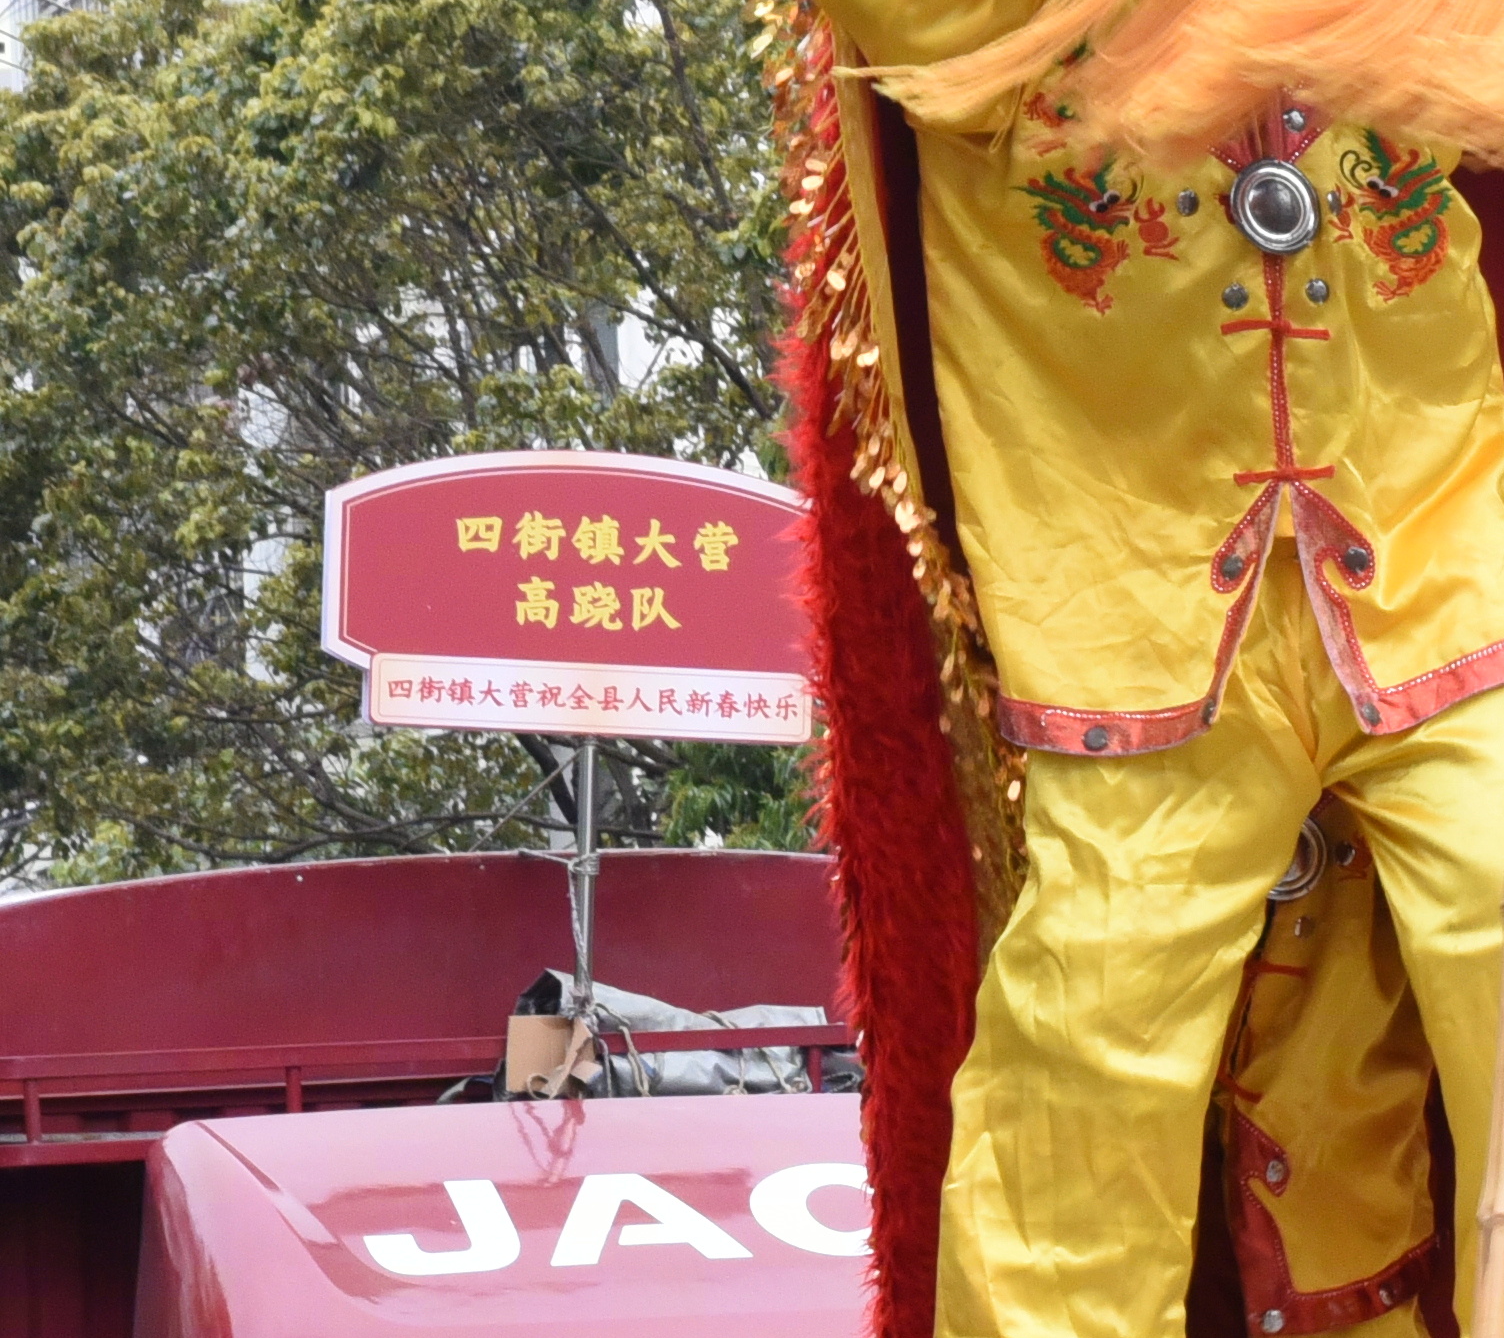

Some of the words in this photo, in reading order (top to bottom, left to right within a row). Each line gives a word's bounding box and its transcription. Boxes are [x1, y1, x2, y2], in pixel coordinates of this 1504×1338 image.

[455, 510, 740, 572] 四街镇大营
[514, 575, 683, 632] 高跷队
[386, 674, 800, 723] 四街镇大营祝全县人民新春快乐
[362, 1161, 876, 1277] JAC
